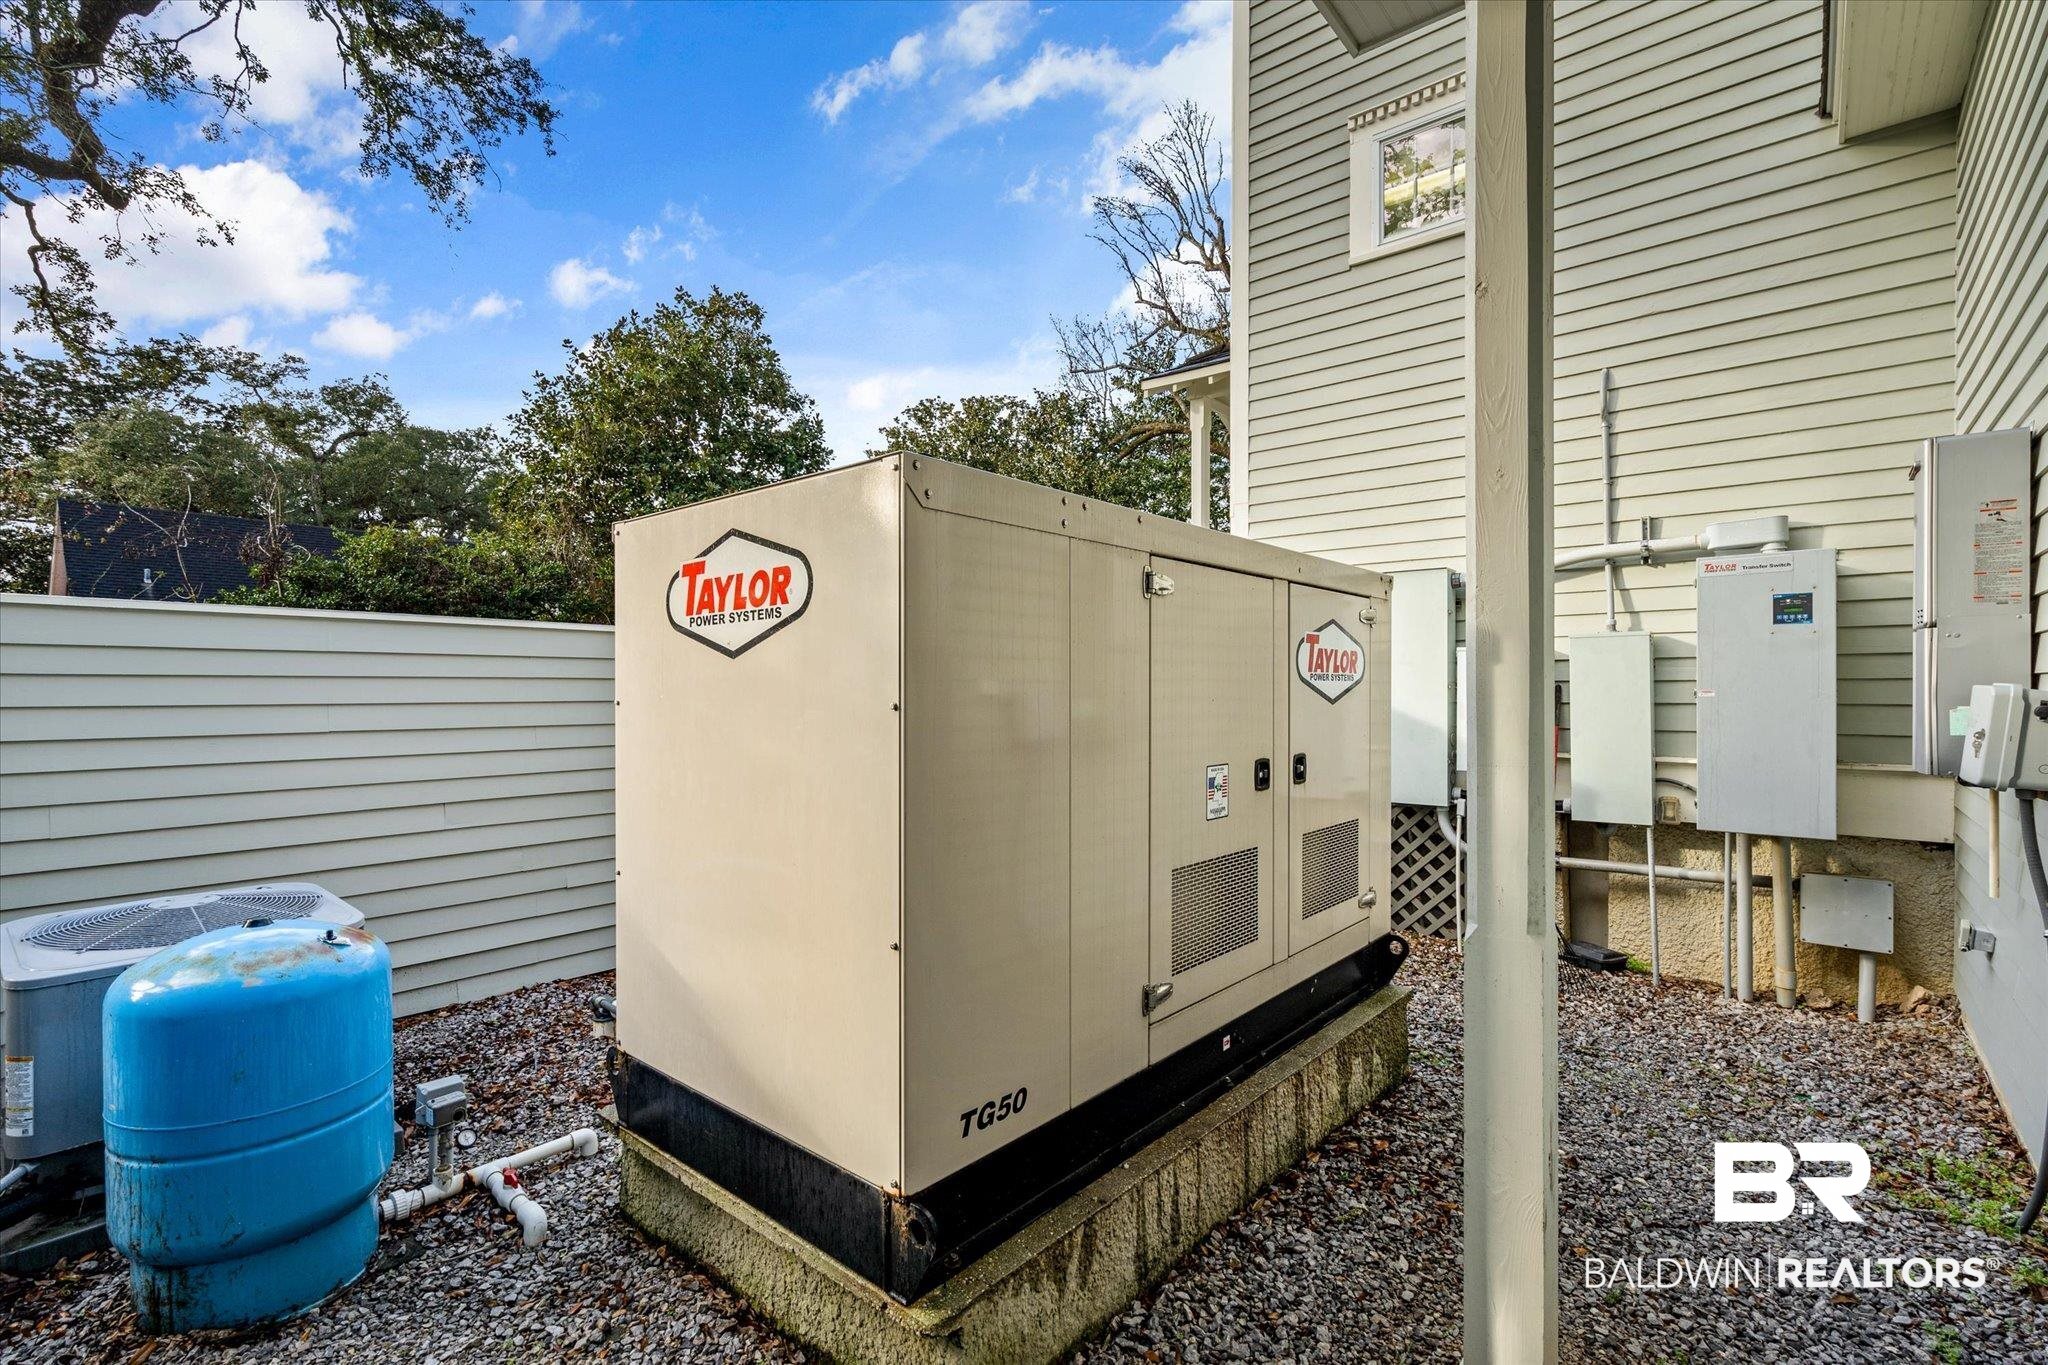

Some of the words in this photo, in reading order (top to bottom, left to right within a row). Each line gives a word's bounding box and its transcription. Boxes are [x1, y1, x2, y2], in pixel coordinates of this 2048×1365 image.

[1704, 563, 1737, 571] TAYLOR
[681, 560, 792, 617] TAYLOR
[689, 613, 726, 628] POWER
[728, 606, 783, 624] SYSTEMS
[1305, 633, 1359, 674] TAYLOR
[1309, 673, 1330, 682] POWER
[1330, 673, 1355, 682] SYSTEMS
[960, 1087, 1028, 1139] TG50
